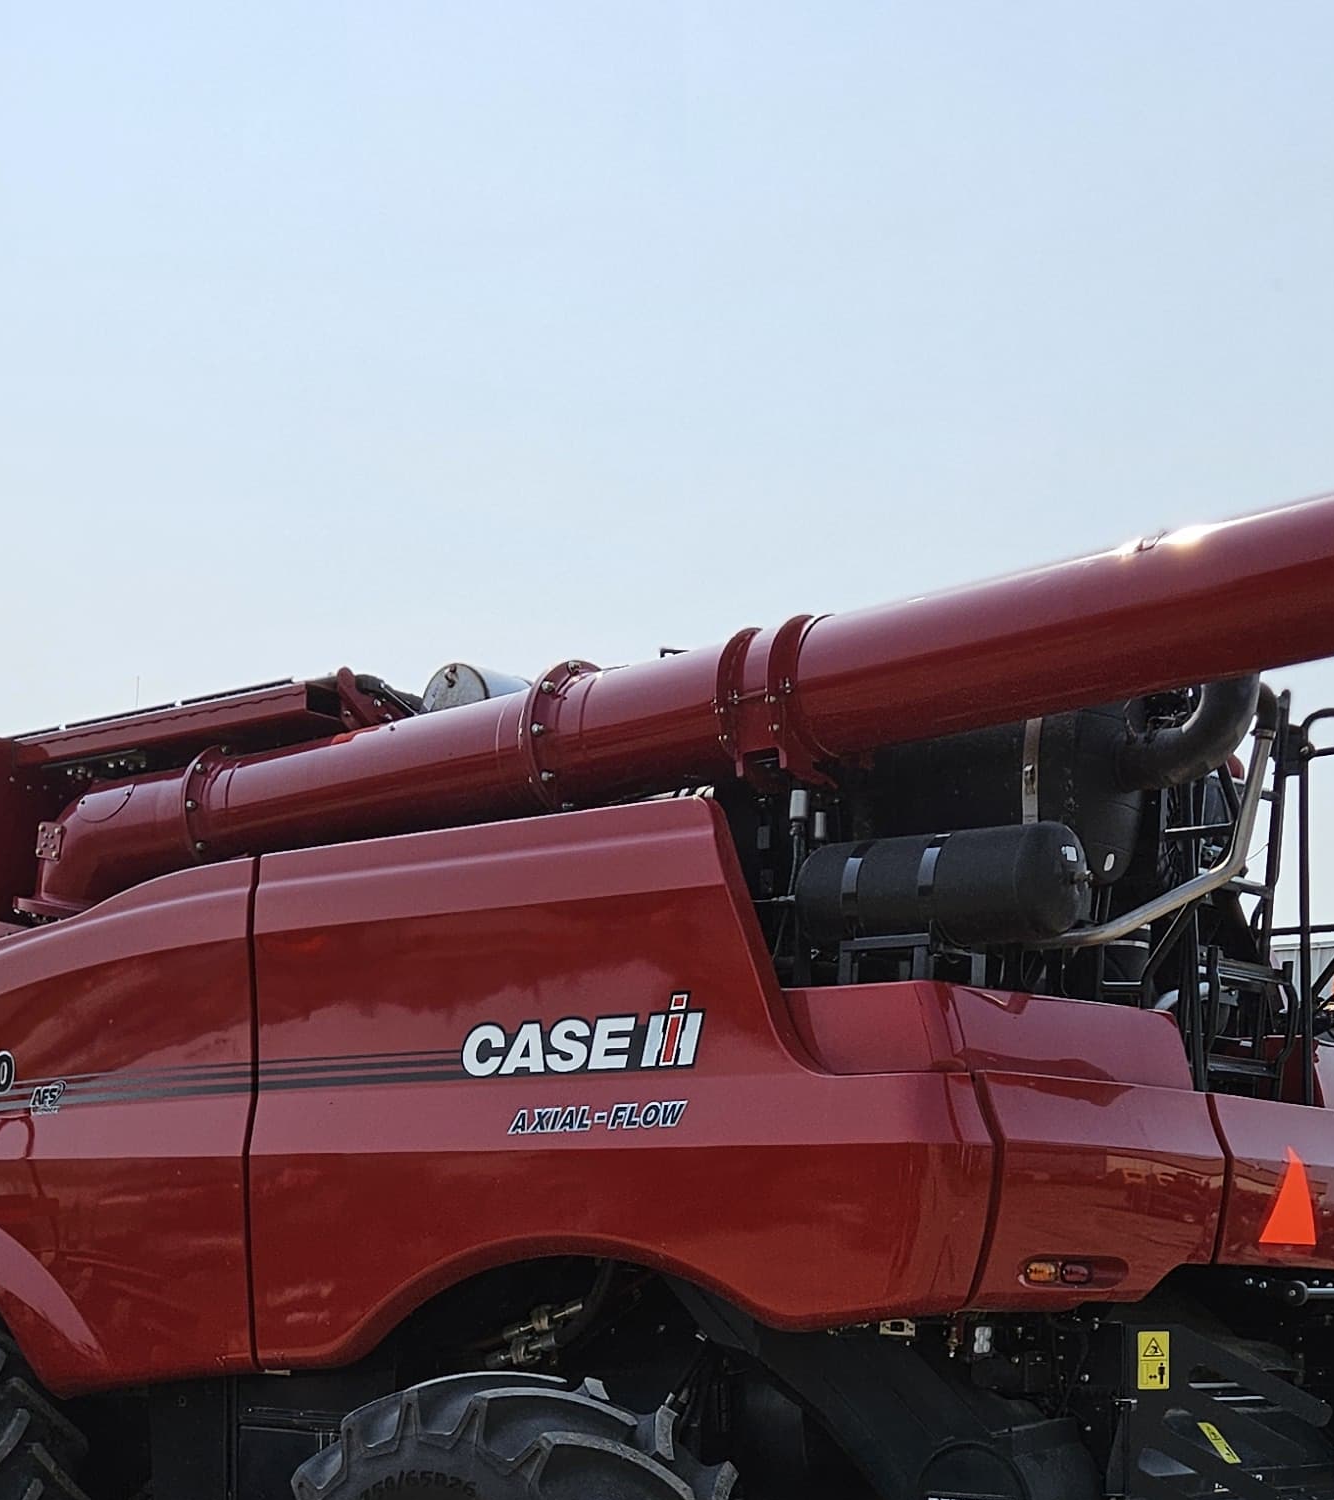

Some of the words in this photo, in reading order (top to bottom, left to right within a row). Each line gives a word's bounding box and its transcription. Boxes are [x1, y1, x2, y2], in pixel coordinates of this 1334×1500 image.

[462, 1016, 637, 1077] CASE
[30, 1085, 61, 1108] AFS
[507, 1100, 688, 1135] AXIAL-FLOW
